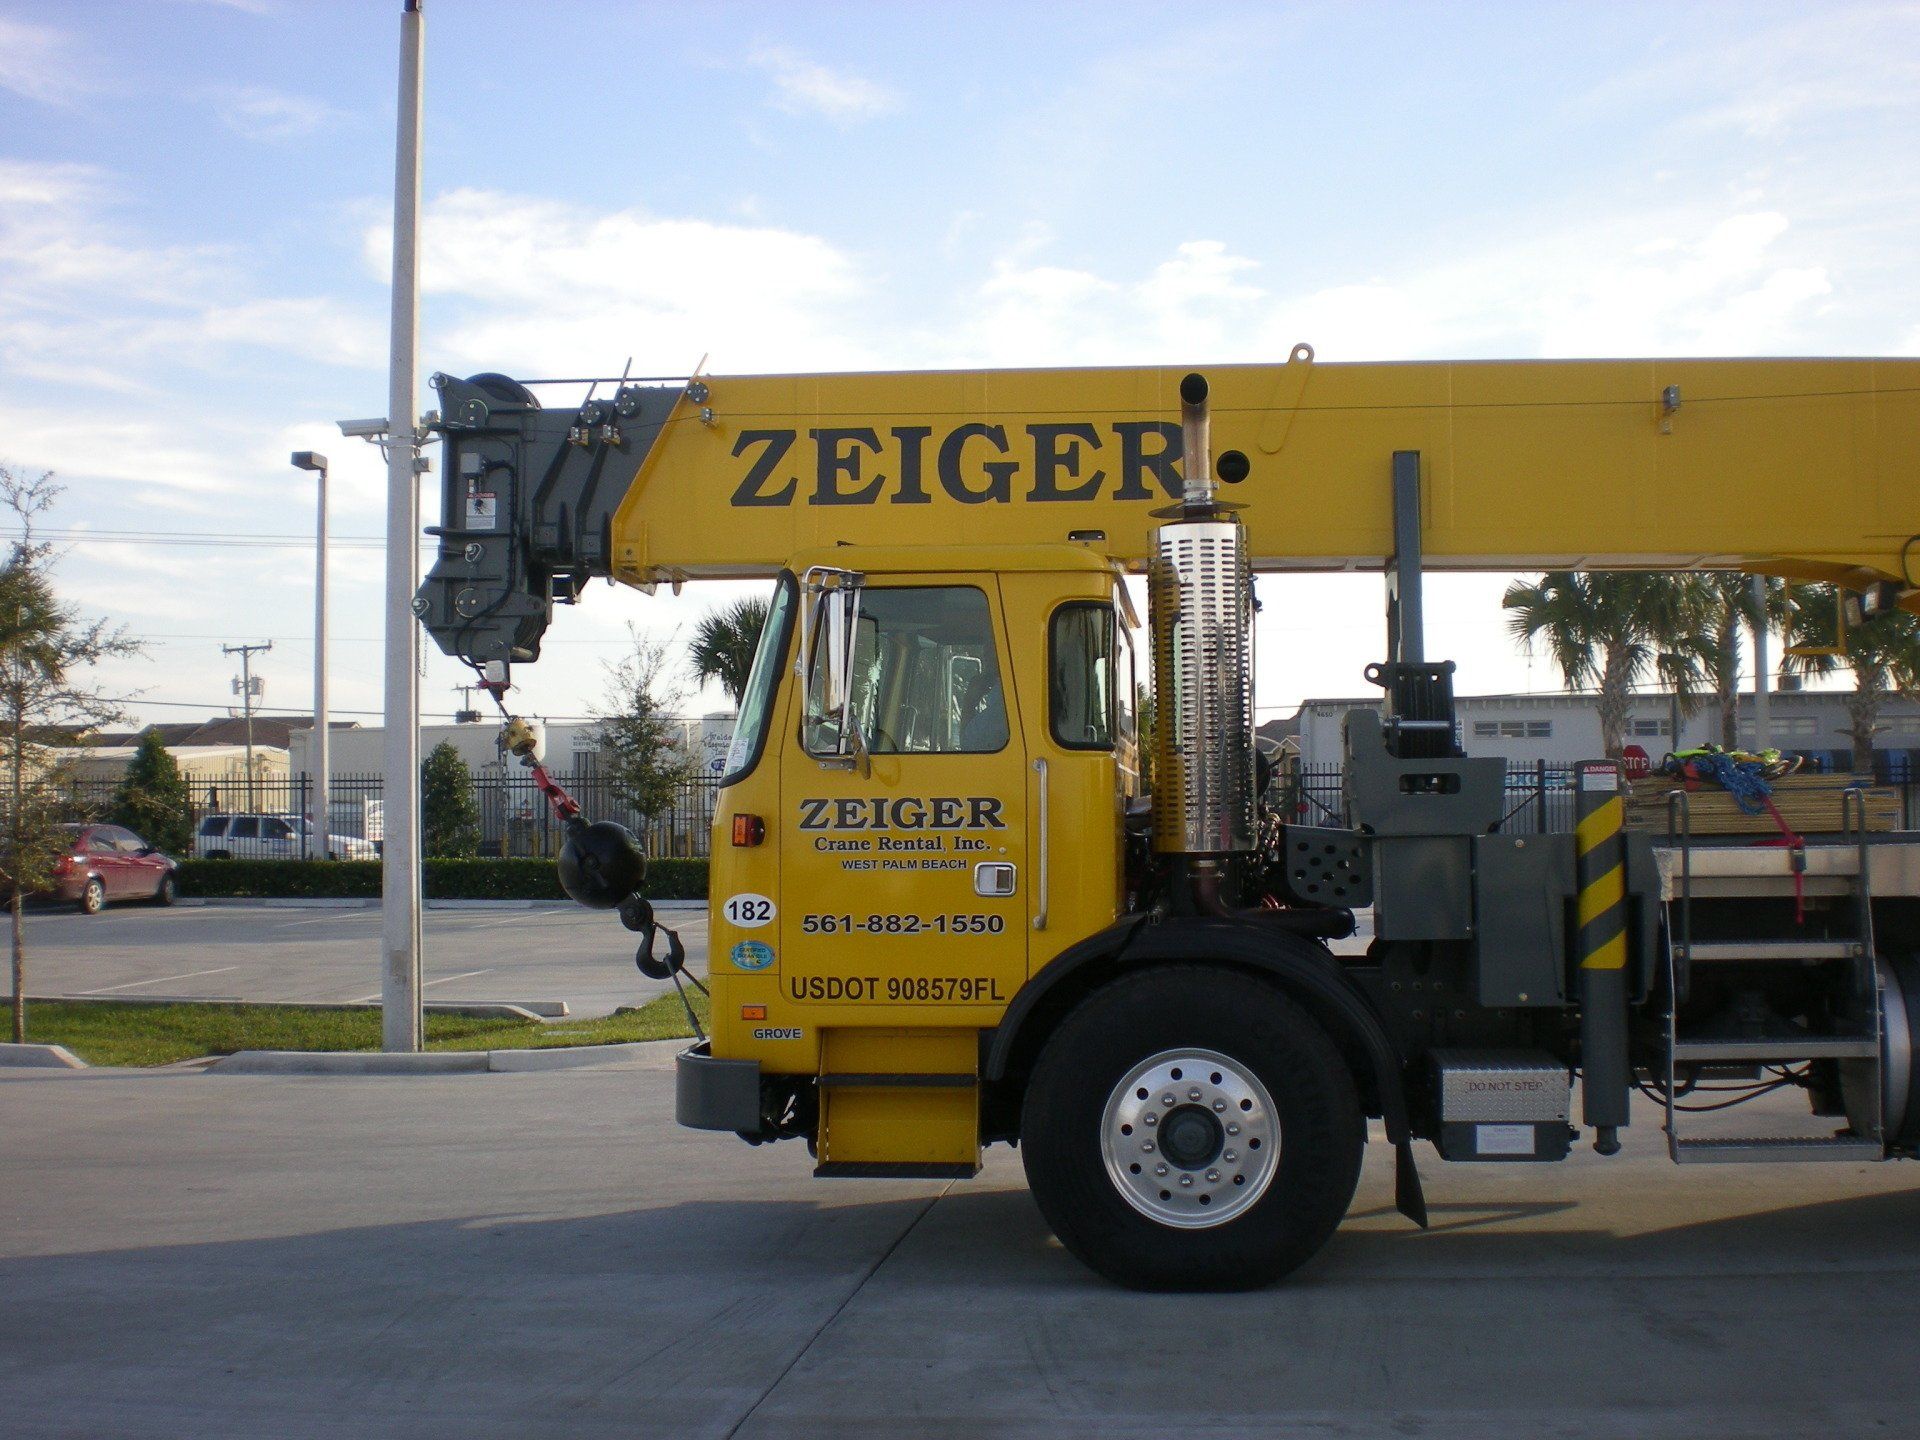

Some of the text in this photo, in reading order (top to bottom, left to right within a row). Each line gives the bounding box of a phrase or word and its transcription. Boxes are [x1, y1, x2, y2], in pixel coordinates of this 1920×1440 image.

[730, 422, 1184, 507] ZEIGER
[1590, 765, 1617, 773] DANGER
[800, 797, 1006, 830] ZEIGER
[814, 835, 992, 853] Crane Rental, Inc.
[842, 858, 968, 870] WEST PALM BEACH
[727, 900, 772, 922] 182
[802, 914, 1005, 934] 561-882-1550
[791, 976, 1006, 1001] USDOT 908579FL
[753, 1028, 802, 1040] GROVE
[1469, 1081, 1543, 1091] DO NOT STEP
